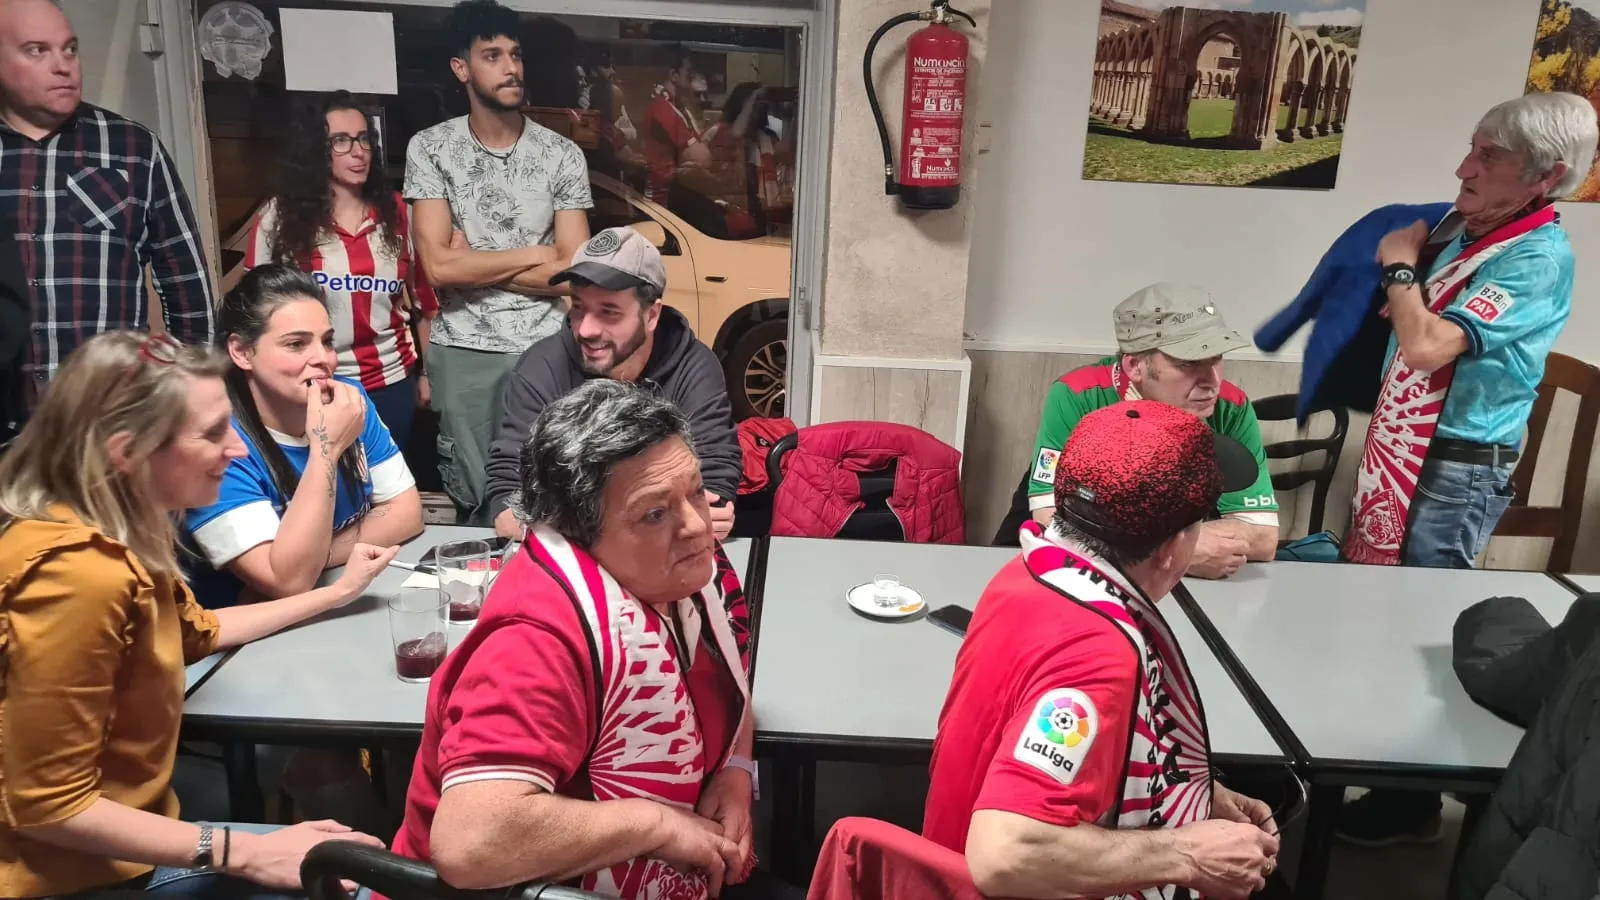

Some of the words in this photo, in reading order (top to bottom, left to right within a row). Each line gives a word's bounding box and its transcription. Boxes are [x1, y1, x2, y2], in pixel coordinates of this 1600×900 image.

[313, 272, 404, 293] Petronor
[1469, 299, 1494, 318] PAY
[1038, 472, 1052, 480] LFP
[1023, 736, 1075, 773] LaLiga
